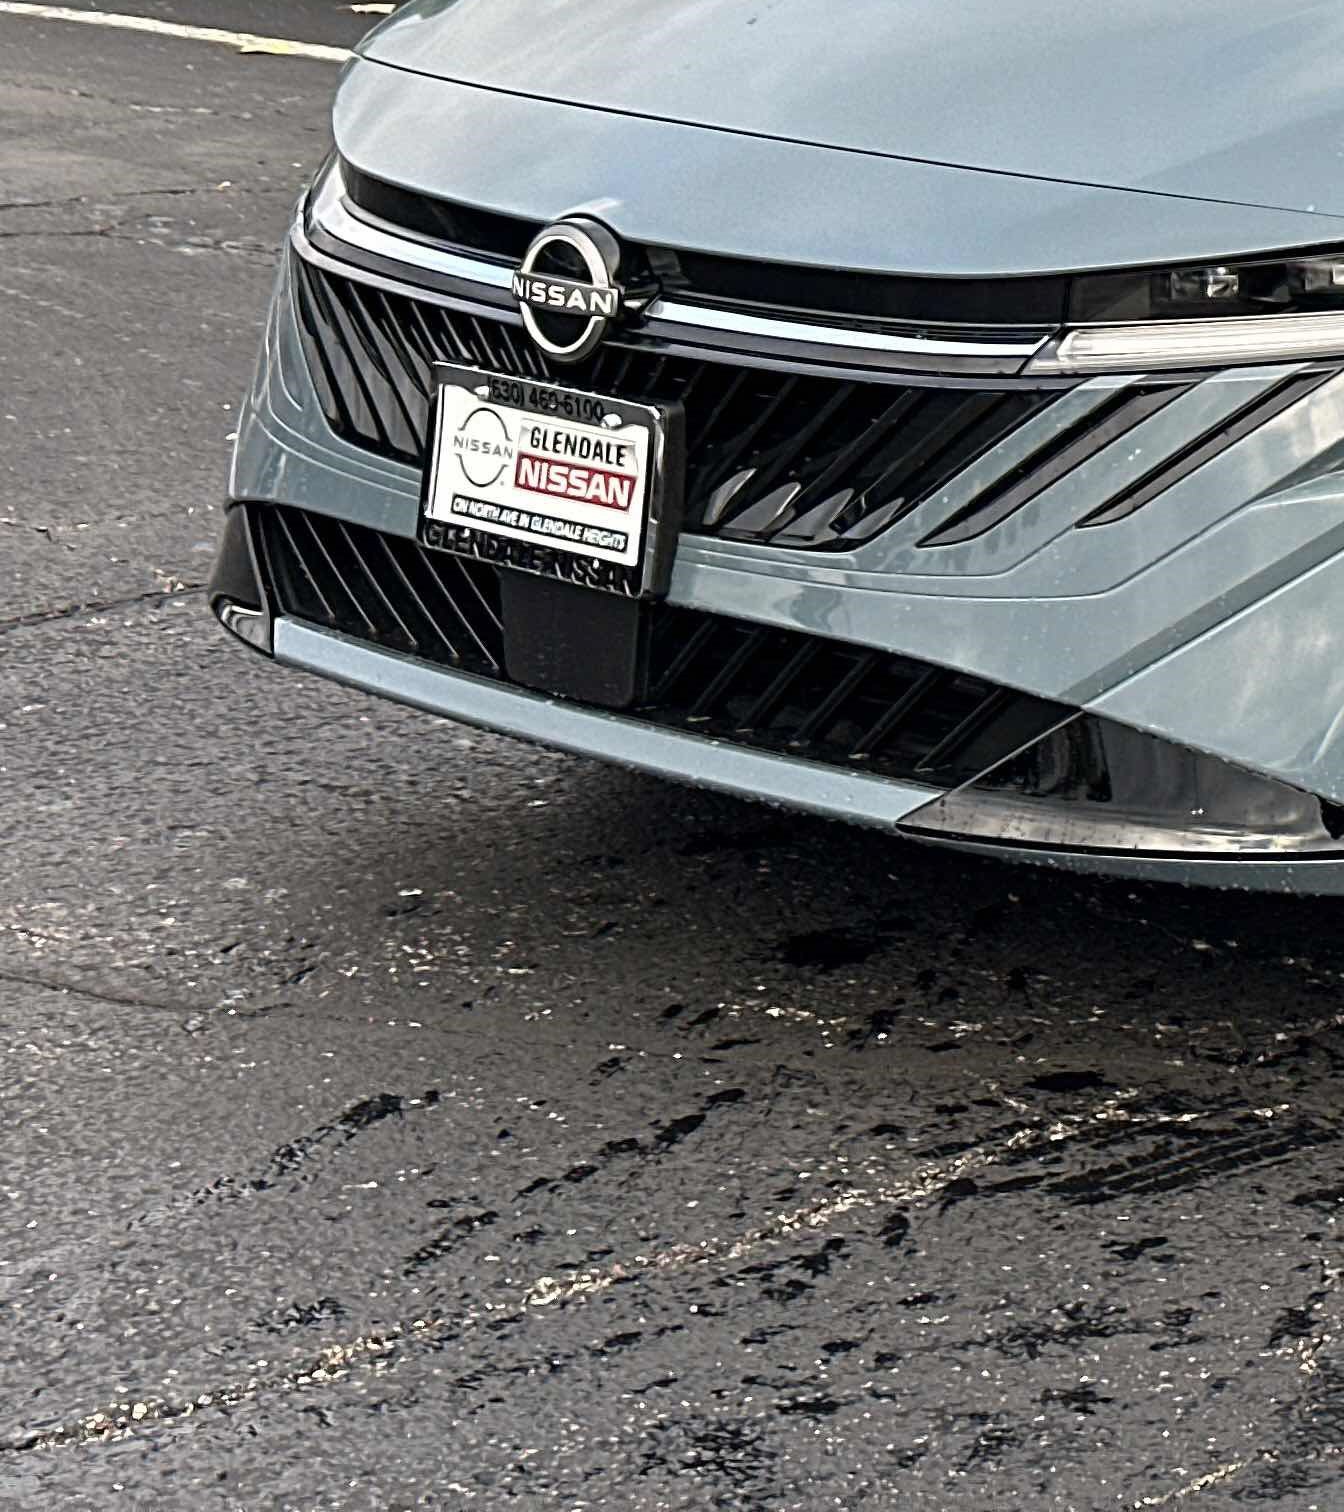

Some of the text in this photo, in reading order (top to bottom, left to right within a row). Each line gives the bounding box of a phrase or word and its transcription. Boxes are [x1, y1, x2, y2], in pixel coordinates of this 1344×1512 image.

[513, 273, 612, 314] NISSAN
[453, 435, 513, 460] NISSAN
[530, 426, 626, 467] GLENDALE
[517, 457, 631, 508] NISSAN
